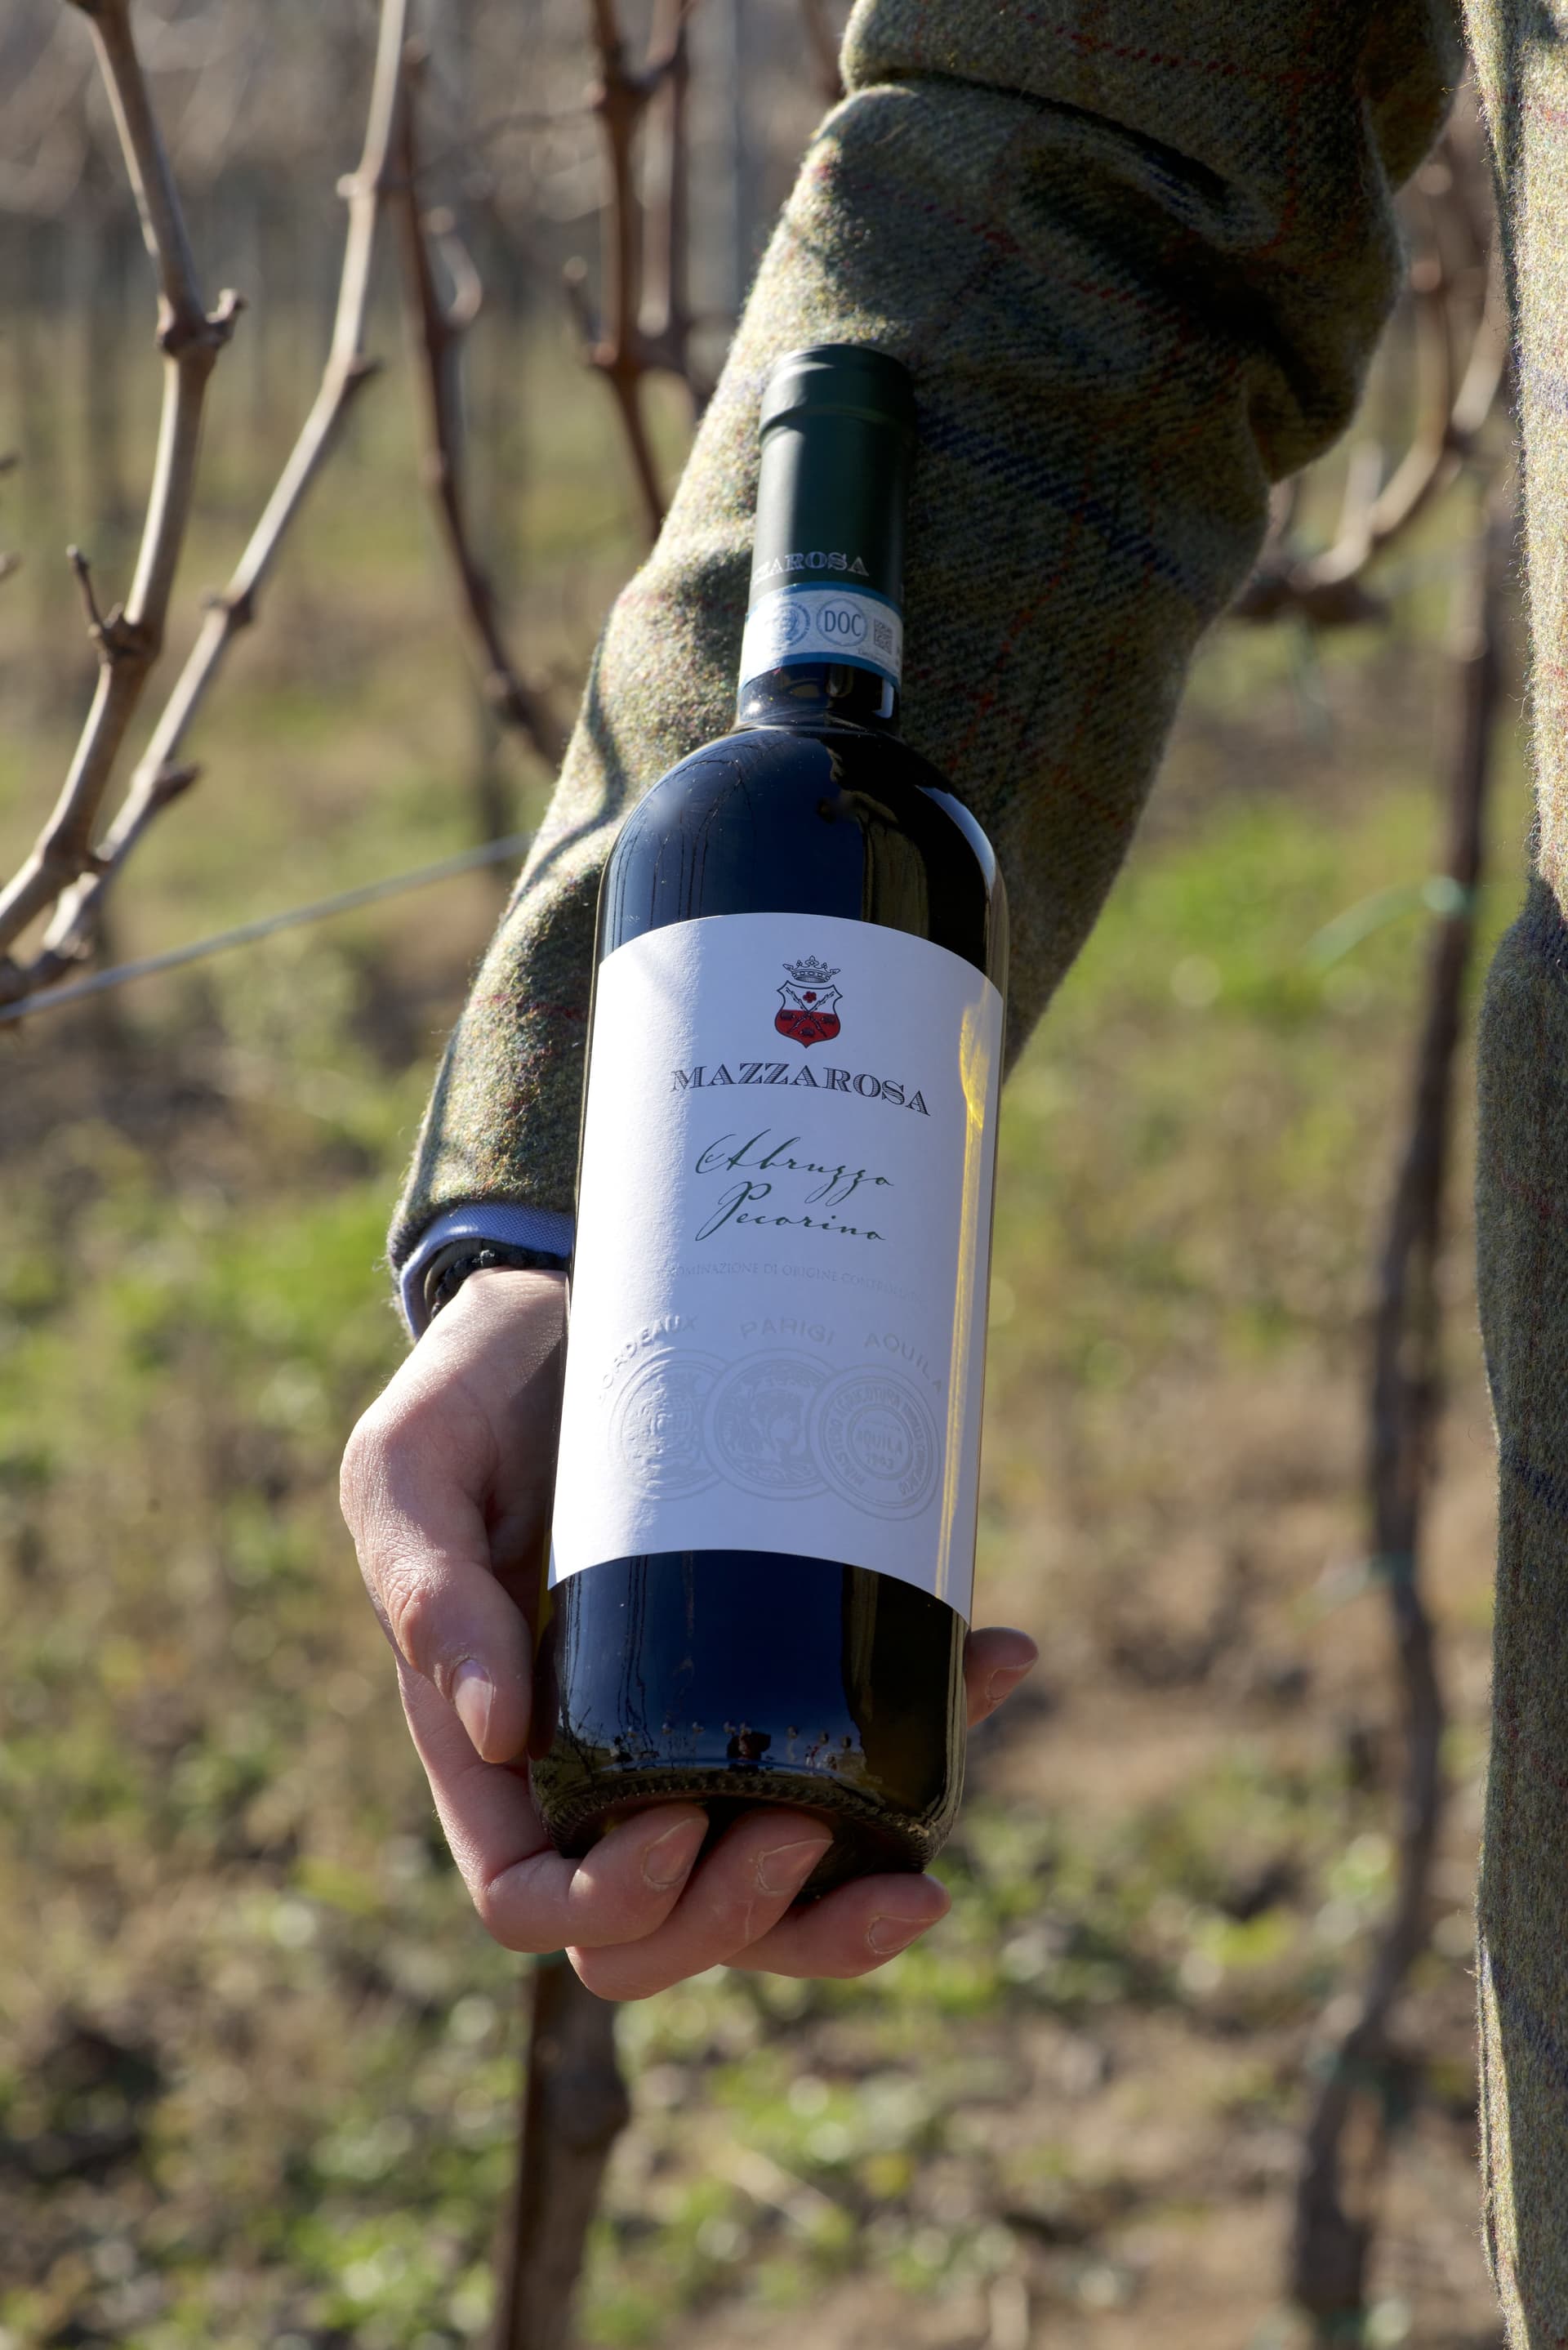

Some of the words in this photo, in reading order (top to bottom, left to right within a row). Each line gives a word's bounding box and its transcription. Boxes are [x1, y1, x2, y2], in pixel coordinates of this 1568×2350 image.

[824, 609, 862, 637] DOC
[670, 1062, 931, 1117] MAZZAROSA
[764, 1263, 778, 1276] DI
[782, 1264, 838, 1282] ORIGINE
[739, 1315, 836, 1347] PARIGI
